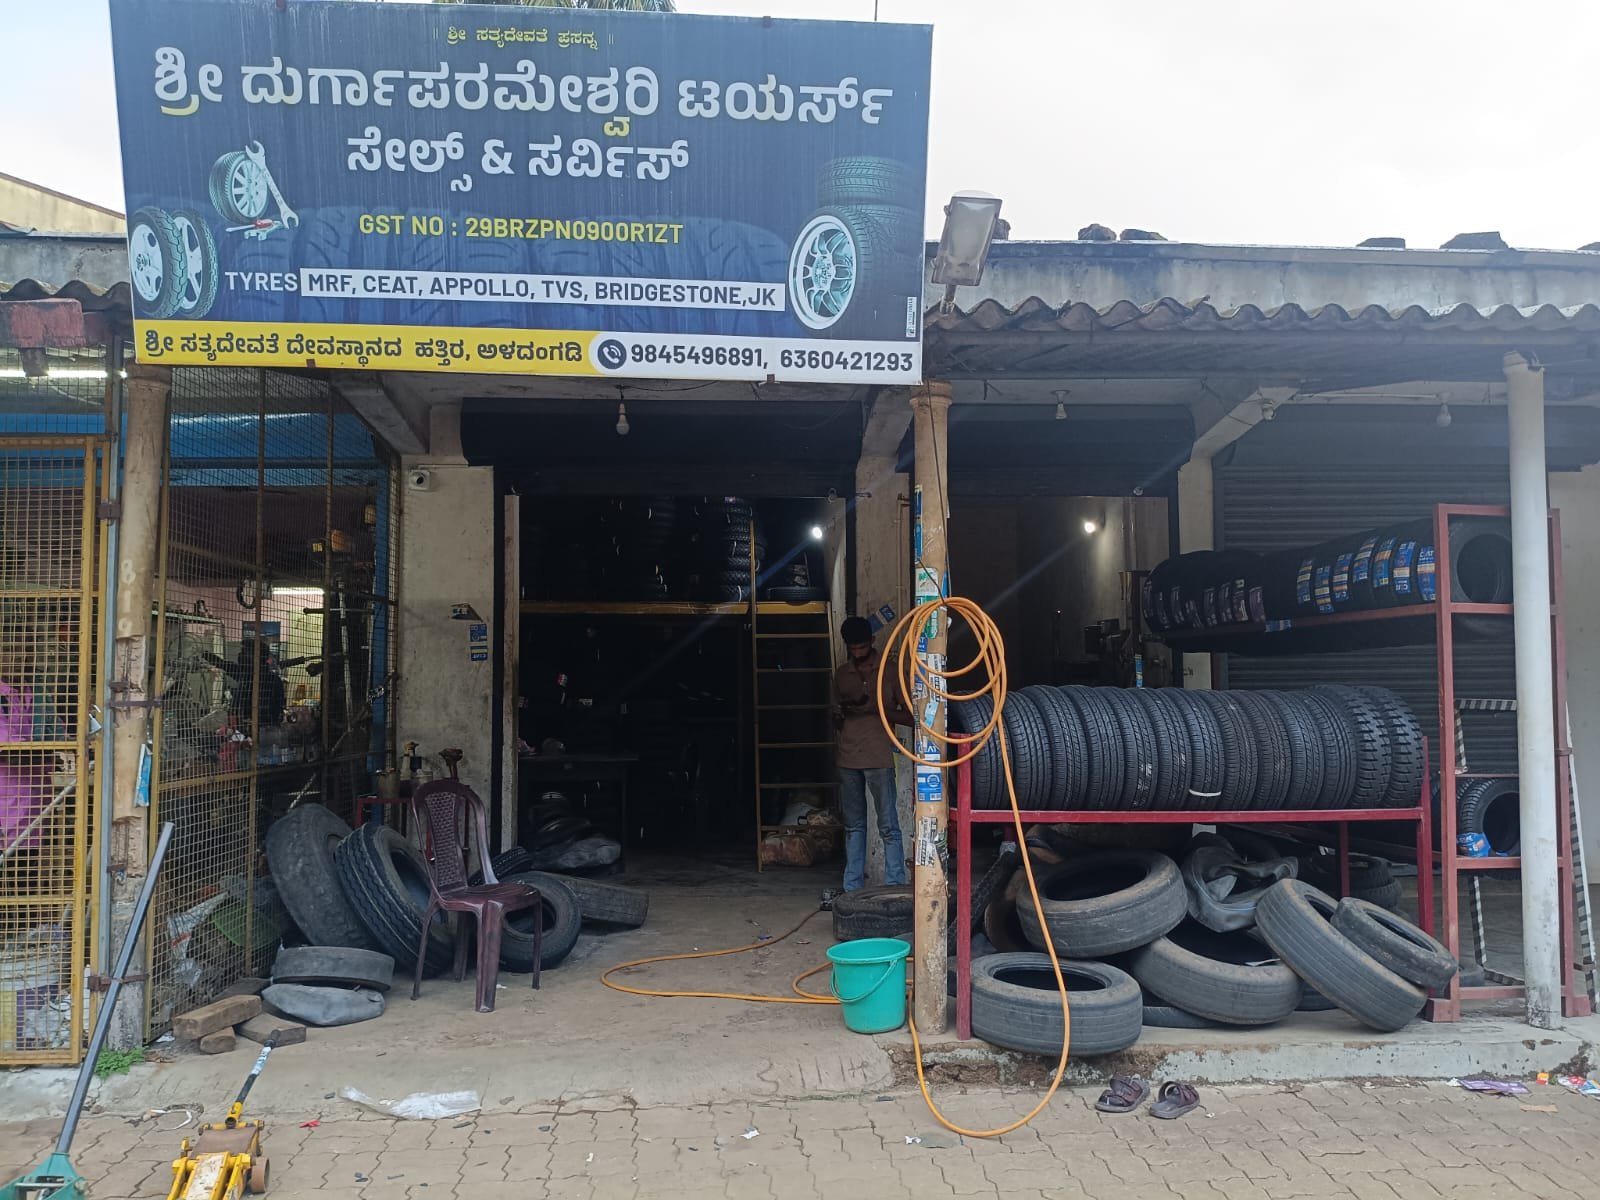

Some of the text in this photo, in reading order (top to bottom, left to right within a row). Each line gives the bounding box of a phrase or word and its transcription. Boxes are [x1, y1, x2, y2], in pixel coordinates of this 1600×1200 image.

[447, 26, 466, 44] ಶ್ರೀ
[476, 27, 548, 48] ಸತ್ಯದೇವತೆ
[558, 30, 599, 50] ಪ್ರಸನ್ನ
[154, 46, 893, 137] ಶ್ರೀ ದುರ್ಗಾಪರಮೇಶ್ವರಿ ಟಯರ್ಸ್
[347, 126, 689, 192] ಸೇಲ್ಸ್ & ಸರ್ವಿಸ್
[359, 214, 405, 235] GST
[411, 215, 444, 236] NO
[465, 217, 683, 244] 29BRZPN0900R1ZT
[225, 271, 298, 292] TYRES
[308, 273, 357, 296] MRF,
[363, 275, 423, 297] CEAT,
[429, 276, 536, 299] APPOLLO,
[541, 280, 588, 302] TVS,
[145, 329, 582, 368] ಶ್ರೀ ಸತ್ಯದೇವತೆ ದೇವಸ್ಥಾನದ ಹತ್ತಿರ, ಅಳದಂಗಡಿ
[631, 344, 913, 372] 9845496891, 6360421293
